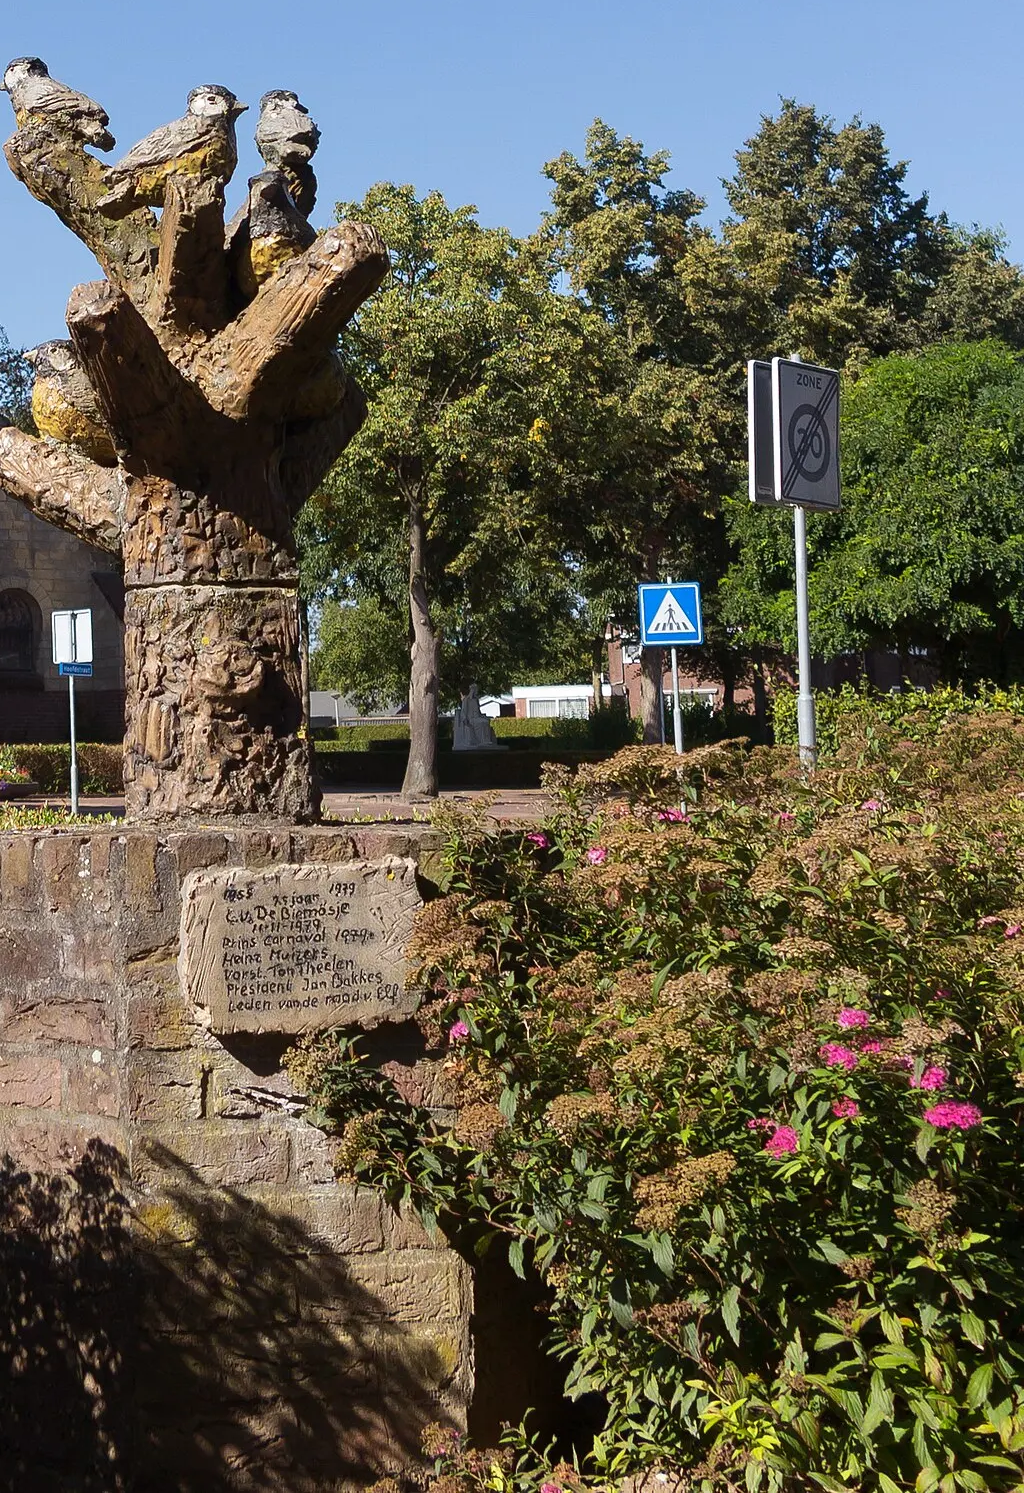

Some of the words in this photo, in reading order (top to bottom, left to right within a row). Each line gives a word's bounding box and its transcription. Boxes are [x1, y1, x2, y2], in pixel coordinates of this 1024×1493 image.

[797, 373, 822, 390] ZONE
[254, 905, 276, 920] De
[302, 977, 327, 992] Jan
[331, 969, 383, 988] Bakkes
